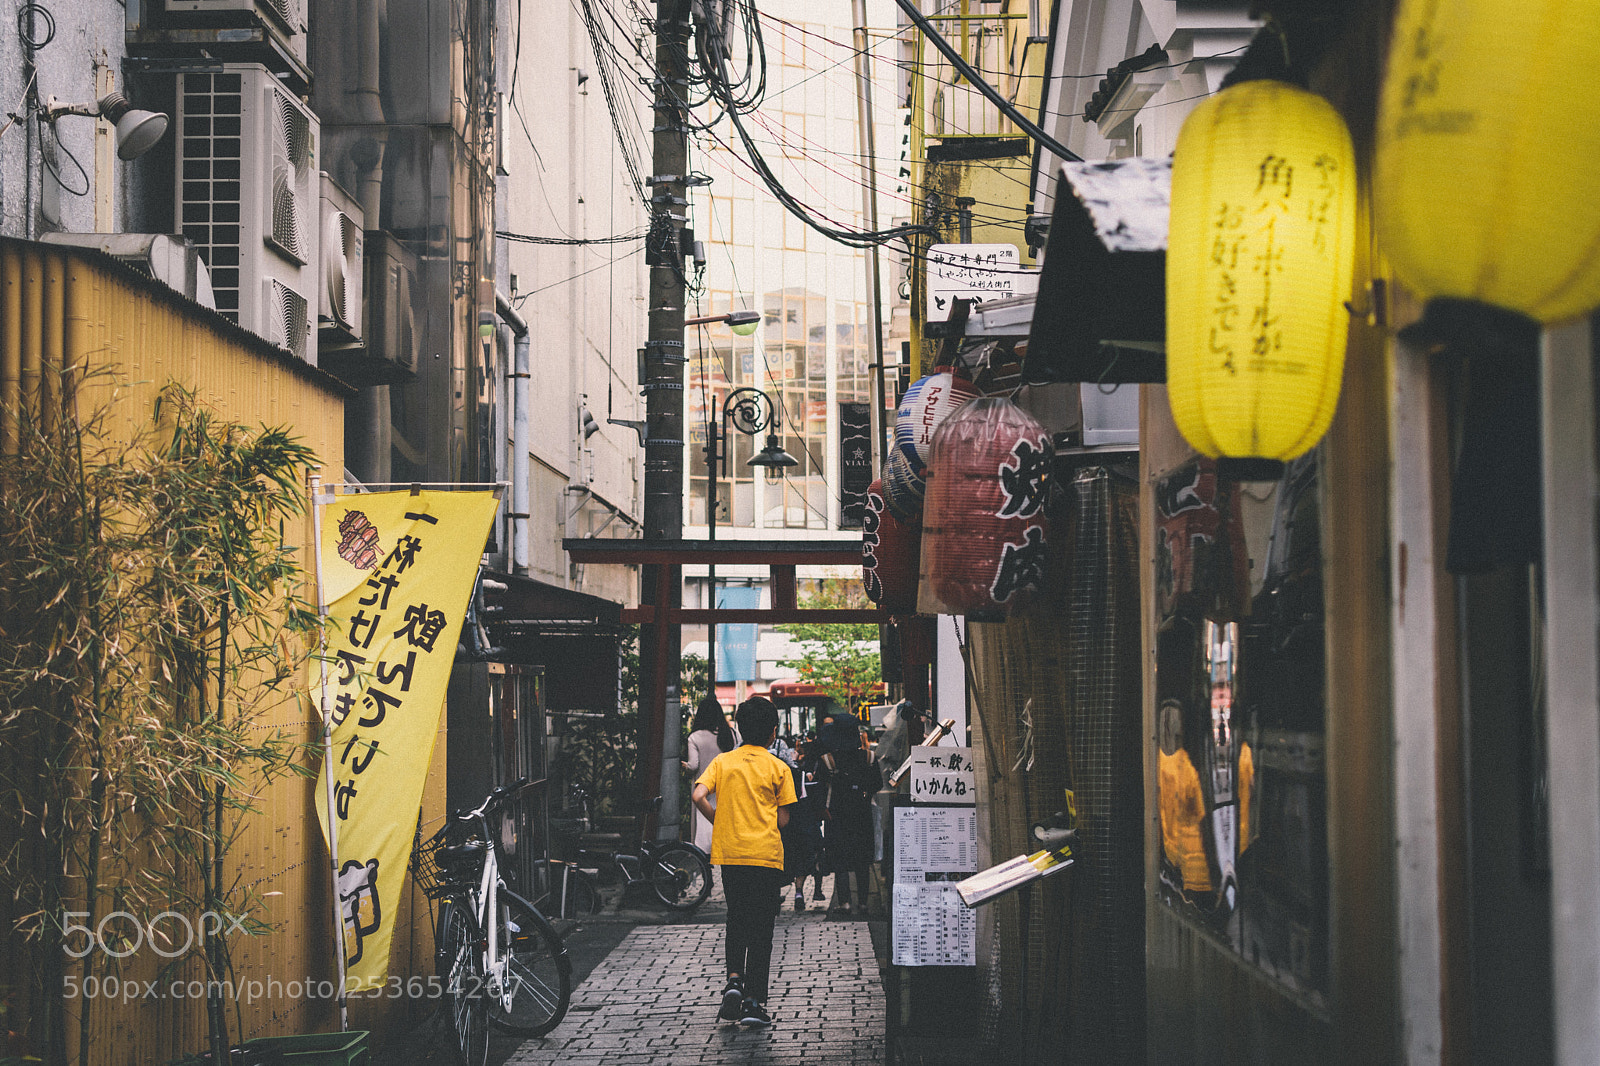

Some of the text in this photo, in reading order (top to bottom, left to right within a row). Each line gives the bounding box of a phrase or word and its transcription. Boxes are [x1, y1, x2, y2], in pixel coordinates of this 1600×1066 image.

[938, 268, 997, 279] しゃぶしゃぶ
[920, 386, 942, 445] アサヒビール
